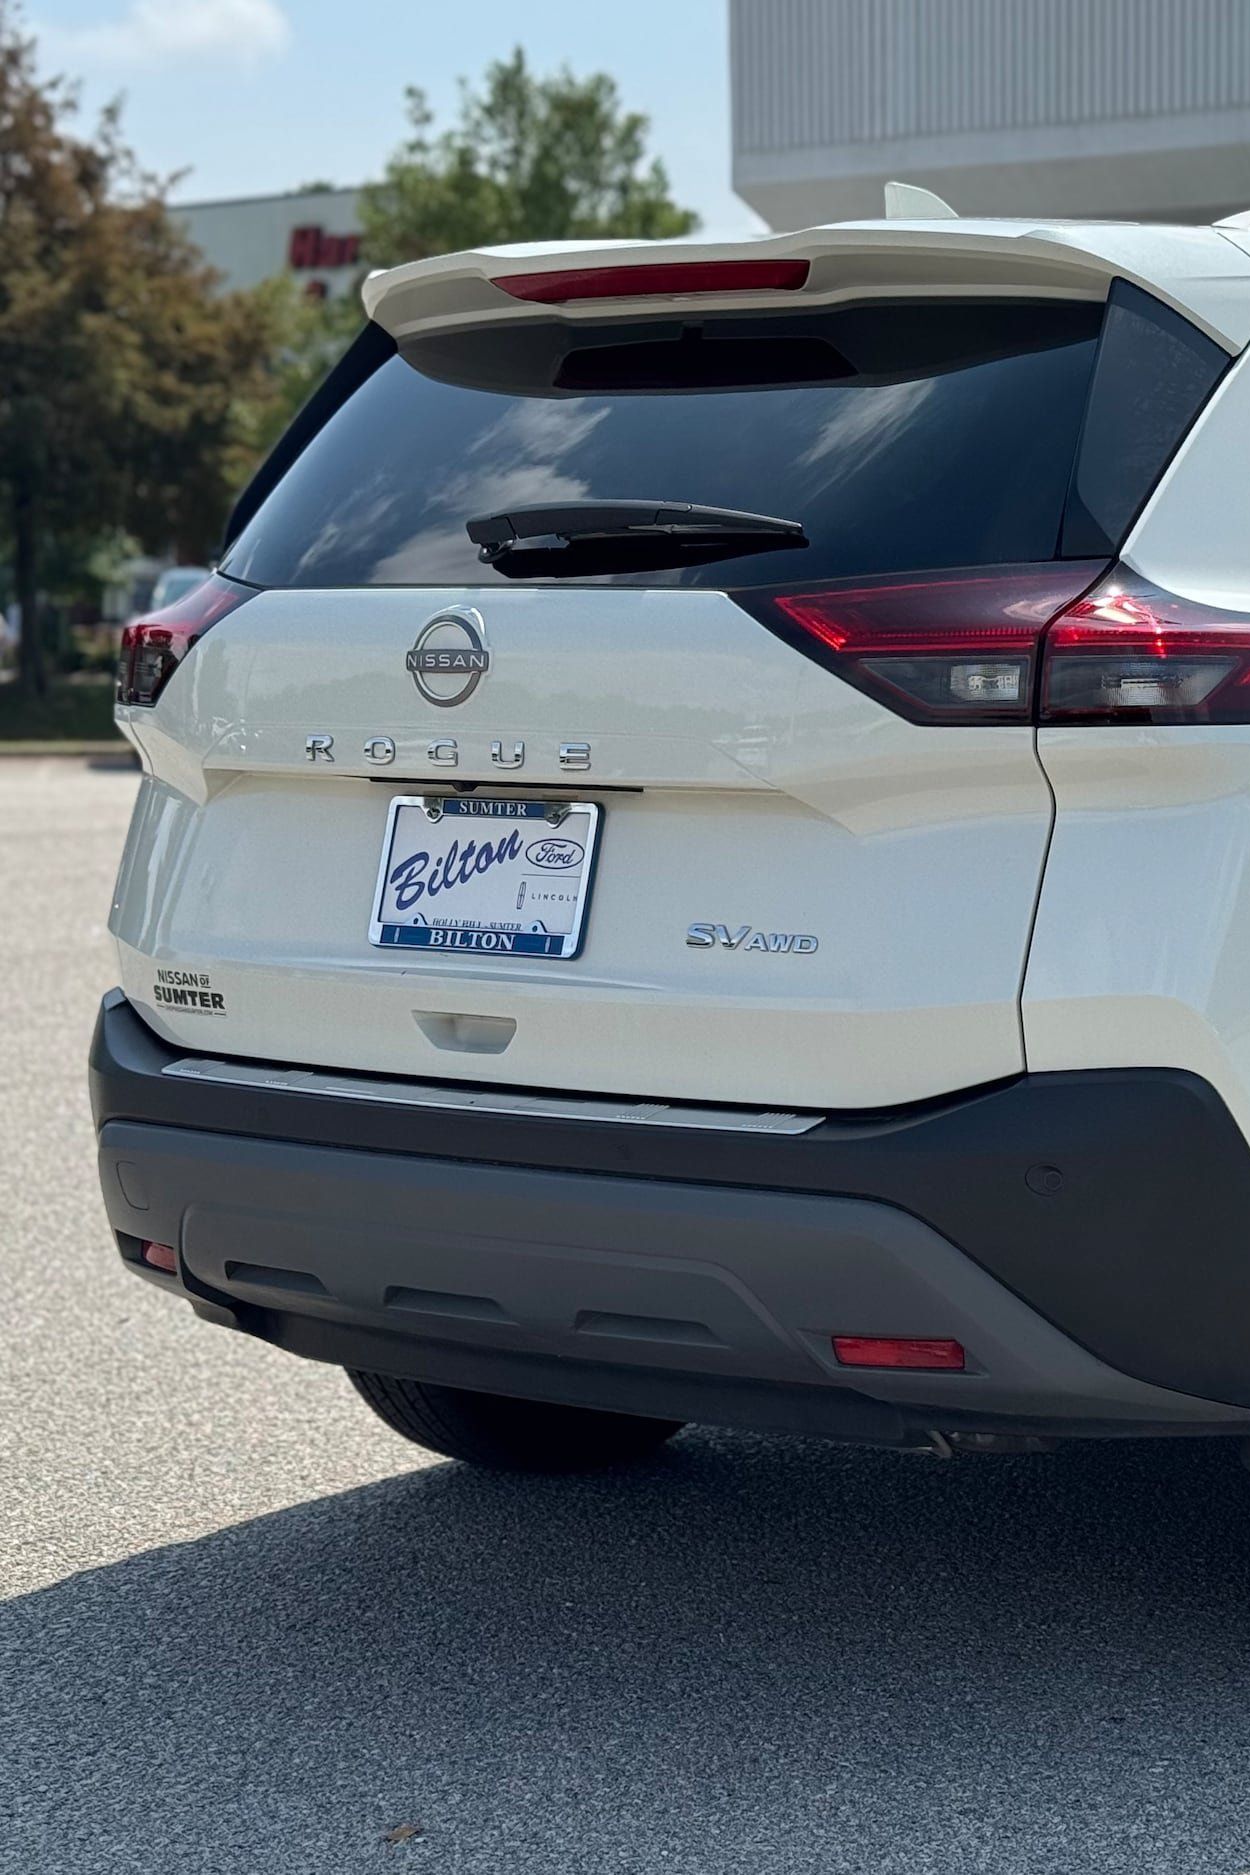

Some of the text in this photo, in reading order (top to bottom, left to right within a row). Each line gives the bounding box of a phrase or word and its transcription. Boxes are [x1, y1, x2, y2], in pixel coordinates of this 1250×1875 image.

[407, 654, 485, 668] NISSAN
[305, 734, 592, 770] ROGUE
[459, 801, 527, 816] SUMTER
[536, 842, 576, 865] Ford
[390, 829, 523, 910] Bilton
[432, 917, 460, 927] HOLLY
[489, 921, 523, 931] SUMTER
[429, 929, 516, 950] BILTON
[686, 923, 819, 954] SV AWD
[157, 969, 199, 988] NISSAN
[154, 984, 226, 1010] SUMTER
